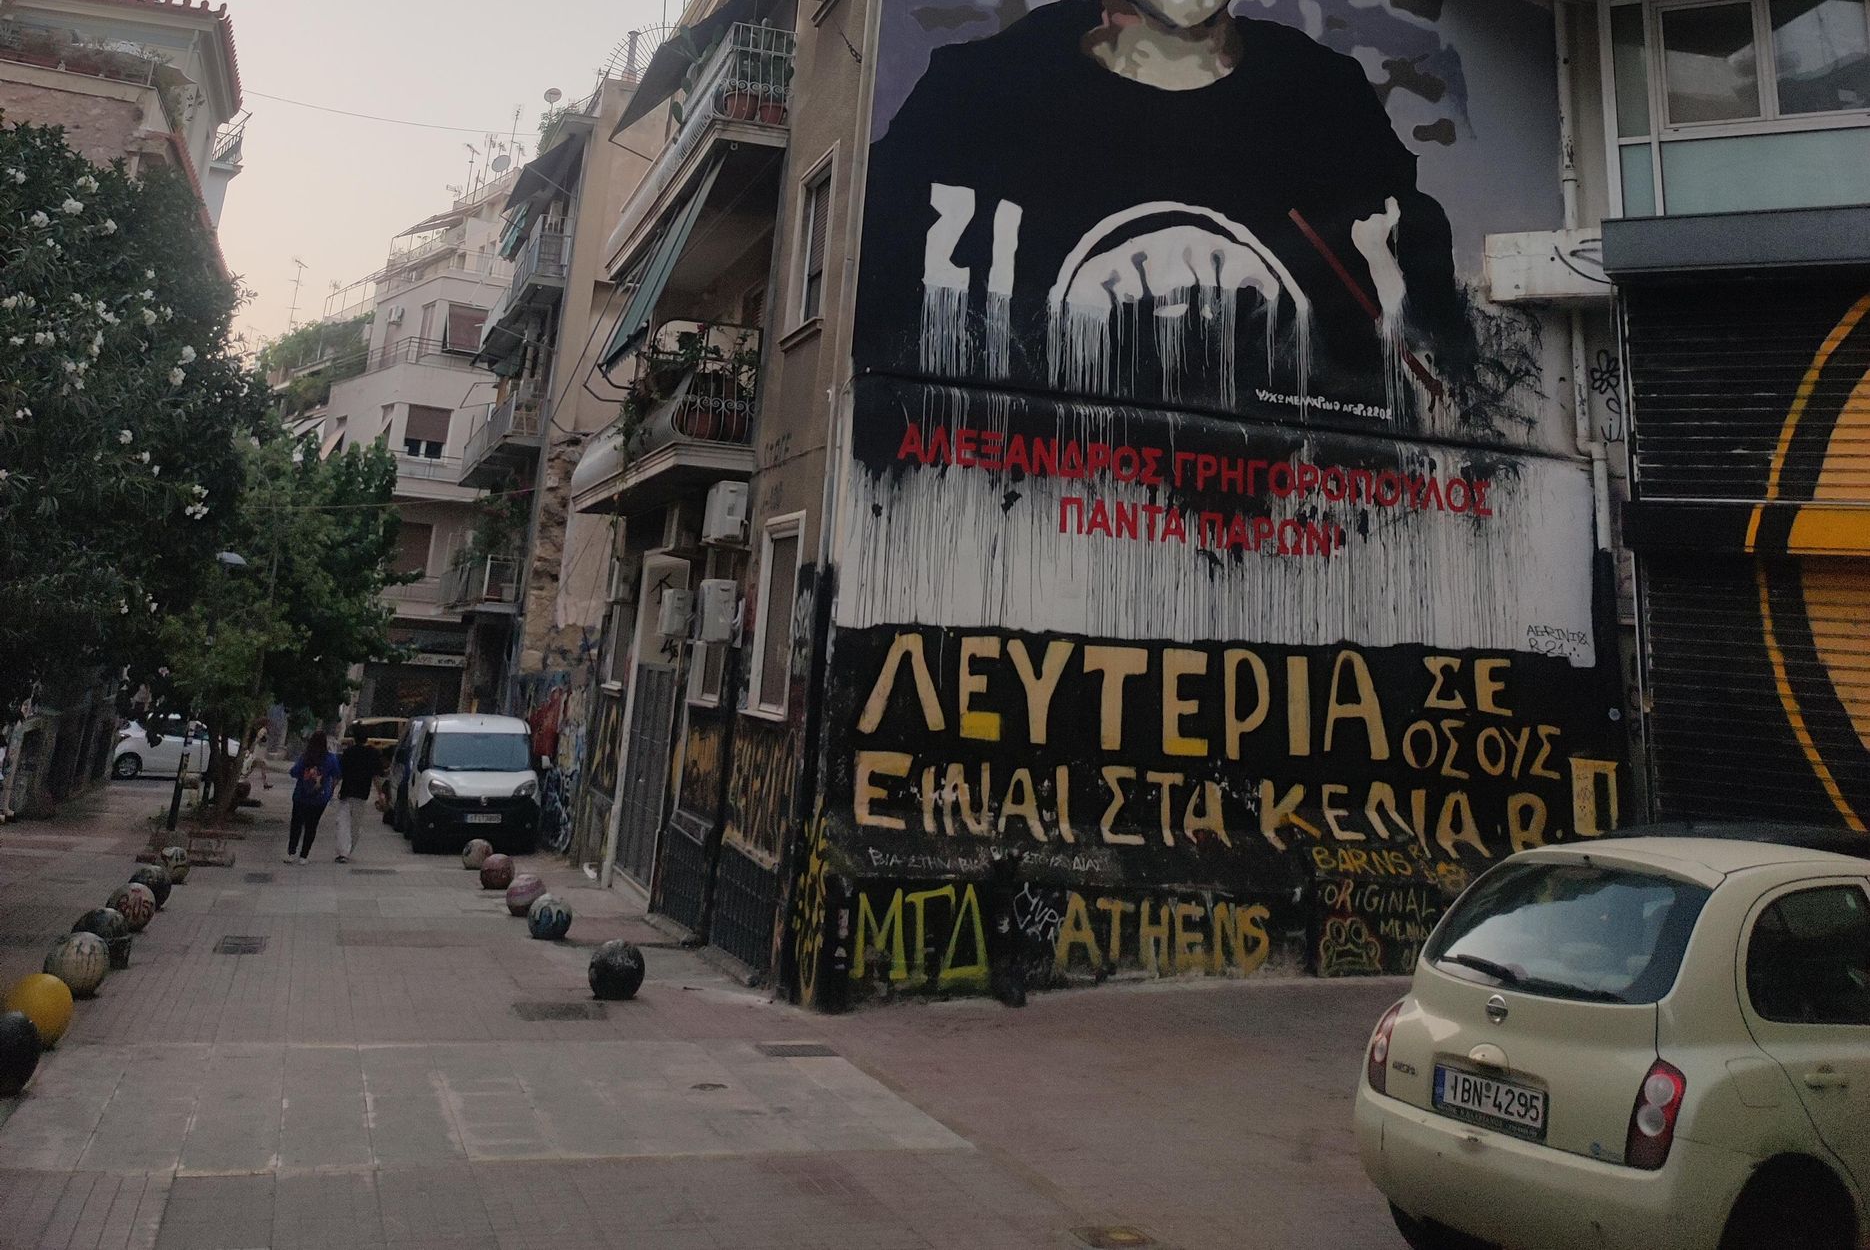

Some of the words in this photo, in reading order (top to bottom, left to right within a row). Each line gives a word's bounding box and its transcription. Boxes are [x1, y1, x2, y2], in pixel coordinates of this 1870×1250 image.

[898, 422, 1162, 489] ΑΛΕΞΑΝΔΡΟΣ
[1175, 452, 1492, 517] ΓΡΗΓΟΡΟΠΟΥΛΟΣ
[1058, 496, 1187, 545] ΠΑΝΤΑ
[1200, 511, 1344, 560] ΠΑΡΩΝ!
[856, 632, 1391, 761] ΛΕΥΤΕΡΙΑ
[1424, 656, 1514, 717] ΣΕ
[1402, 719, 1561, 782] ΟΣΟΥΣ
[854, 750, 1078, 846] ΕΙΝΑΙ
[1100, 764, 1234, 850] ΣΤΑ
[1055, 892, 1270, 978] ATHENS
